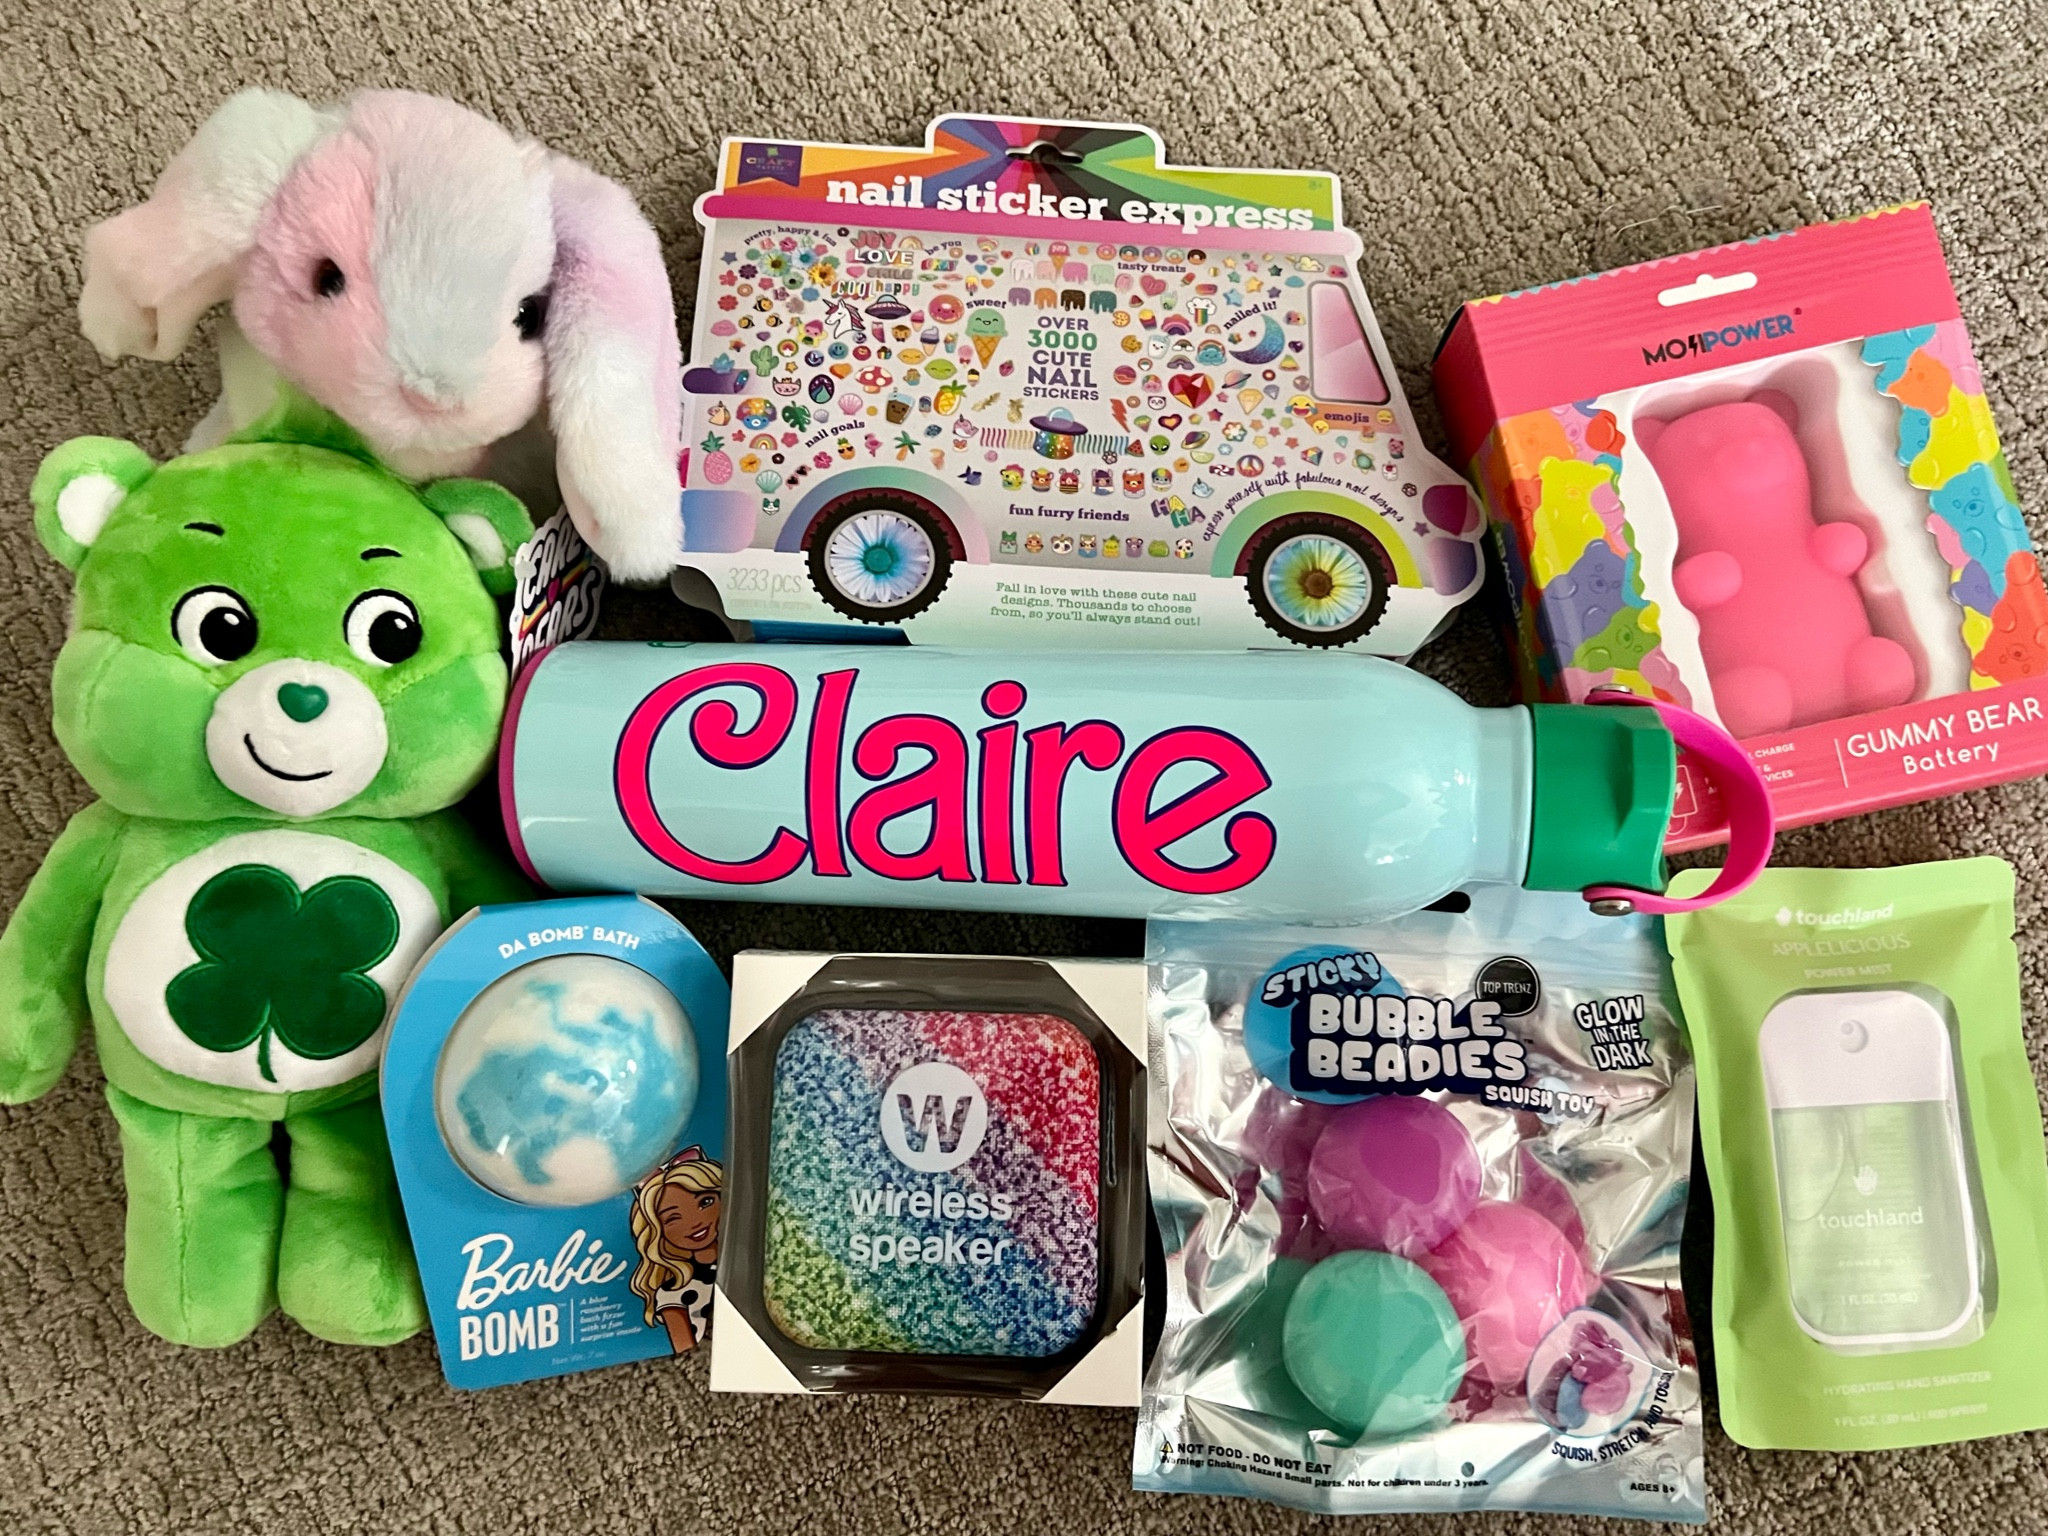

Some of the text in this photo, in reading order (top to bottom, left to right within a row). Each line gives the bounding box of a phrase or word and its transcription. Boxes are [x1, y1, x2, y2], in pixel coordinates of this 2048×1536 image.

[826, 175, 1314, 235] nail sticker express
[777, 225, 811, 236] happy
[822, 233, 837, 247] fun
[850, 229, 896, 249] JOY
[853, 249, 914, 265] LOVE
[924, 240, 962, 256] be you
[1117, 262, 1186, 273] tasty treats
[836, 280, 875, 298] COOL
[876, 279, 920, 296] happy
[966, 298, 1007, 309] sweet
[1037, 316, 1089, 330] OVER
[1223, 301, 1277, 331] nailed it!
[1027, 329, 1098, 351] 3000
[1032, 350, 1092, 368] CUTE
[1027, 365, 1098, 388] NAIL
[1023, 386, 1099, 401] STICKERS
[1324, 412, 1369, 424] emojis
[805, 419, 865, 448] nail goals
[1225, 480, 1265, 514] yourself
[1264, 470, 1290, 487] with
[1295, 471, 1342, 489] fabulous
[1346, 482, 1369, 495] nail
[1370, 493, 1405, 522] designs
[1009, 504, 1130, 521] fun furry friends
[726, 567, 802, 599] 3233 pcs
[996, 582, 1197, 602] Fall in love with these cute nail
[1000, 594, 1192, 614] designs. Thousands to choose
[991, 606, 1201, 626] from, so you'll always stand out!
[1847, 697, 2044, 758] GUMMY BEAR
[1754, 742, 1795, 758] CHARGE
[1902, 742, 1999, 775] Battery
[613, 663, 1276, 894] Claire
[1763, 769, 1794, 782] VICES
[1795, 903, 1894, 925] touchland
[498, 926, 640, 959] DA BOMB BATH
[1772, 933, 1911, 956] APPLELICIOUS
[1263, 952, 1381, 1001] STICKY
[1804, 963, 1892, 978] POWER MIST
[1483, 981, 1531, 994] TOP TRENZ
[1309, 993, 1504, 1040] BUBBLE
[1575, 996, 1644, 1029] GLOW
[1594, 1023, 1640, 1043] IN THE
[1308, 1038, 1526, 1082] BEADIES
[1592, 1041, 1652, 1070] DARK
[1485, 1085, 1594, 1114] SQUISH TOY
[897, 1094, 973, 1153] W
[850, 1183, 1012, 1221] wireless
[1819, 1206, 1924, 1229] touchland
[849, 1232, 1013, 1270] speaker
[456, 1229, 628, 1311] Barbie
[460, 1304, 559, 1361] BOMB
[1823, 1380, 1895, 1396] HYDRATING
[1933, 1371, 1992, 1388] SANITIZER
[1552, 1441, 1597, 1462] SQUISH,
[1643, 1404, 1663, 1429] AND
[1178, 1443, 1204, 1454] NOT
[1208, 1445, 1243, 1459] FOOD
[1253, 1453, 1270, 1464] DO
[1274, 1458, 1301, 1470] NOT
[1305, 1463, 1332, 1475] EAT
[1207, 1458, 1247, 1472] Choking
[1250, 1465, 1282, 1478] Hazard
[1285, 1472, 1312, 1484] Small
[1315, 1478, 1344, 1488] parts.
[1348, 1479, 1365, 1487] Not
[1367, 1479, 1380, 1487] for
[1384, 1478, 1421, 1487] children
[1424, 1479, 1451, 1487] under
[1454, 1479, 1460, 1487] 3
[1630, 1483, 1659, 1492] AGES
